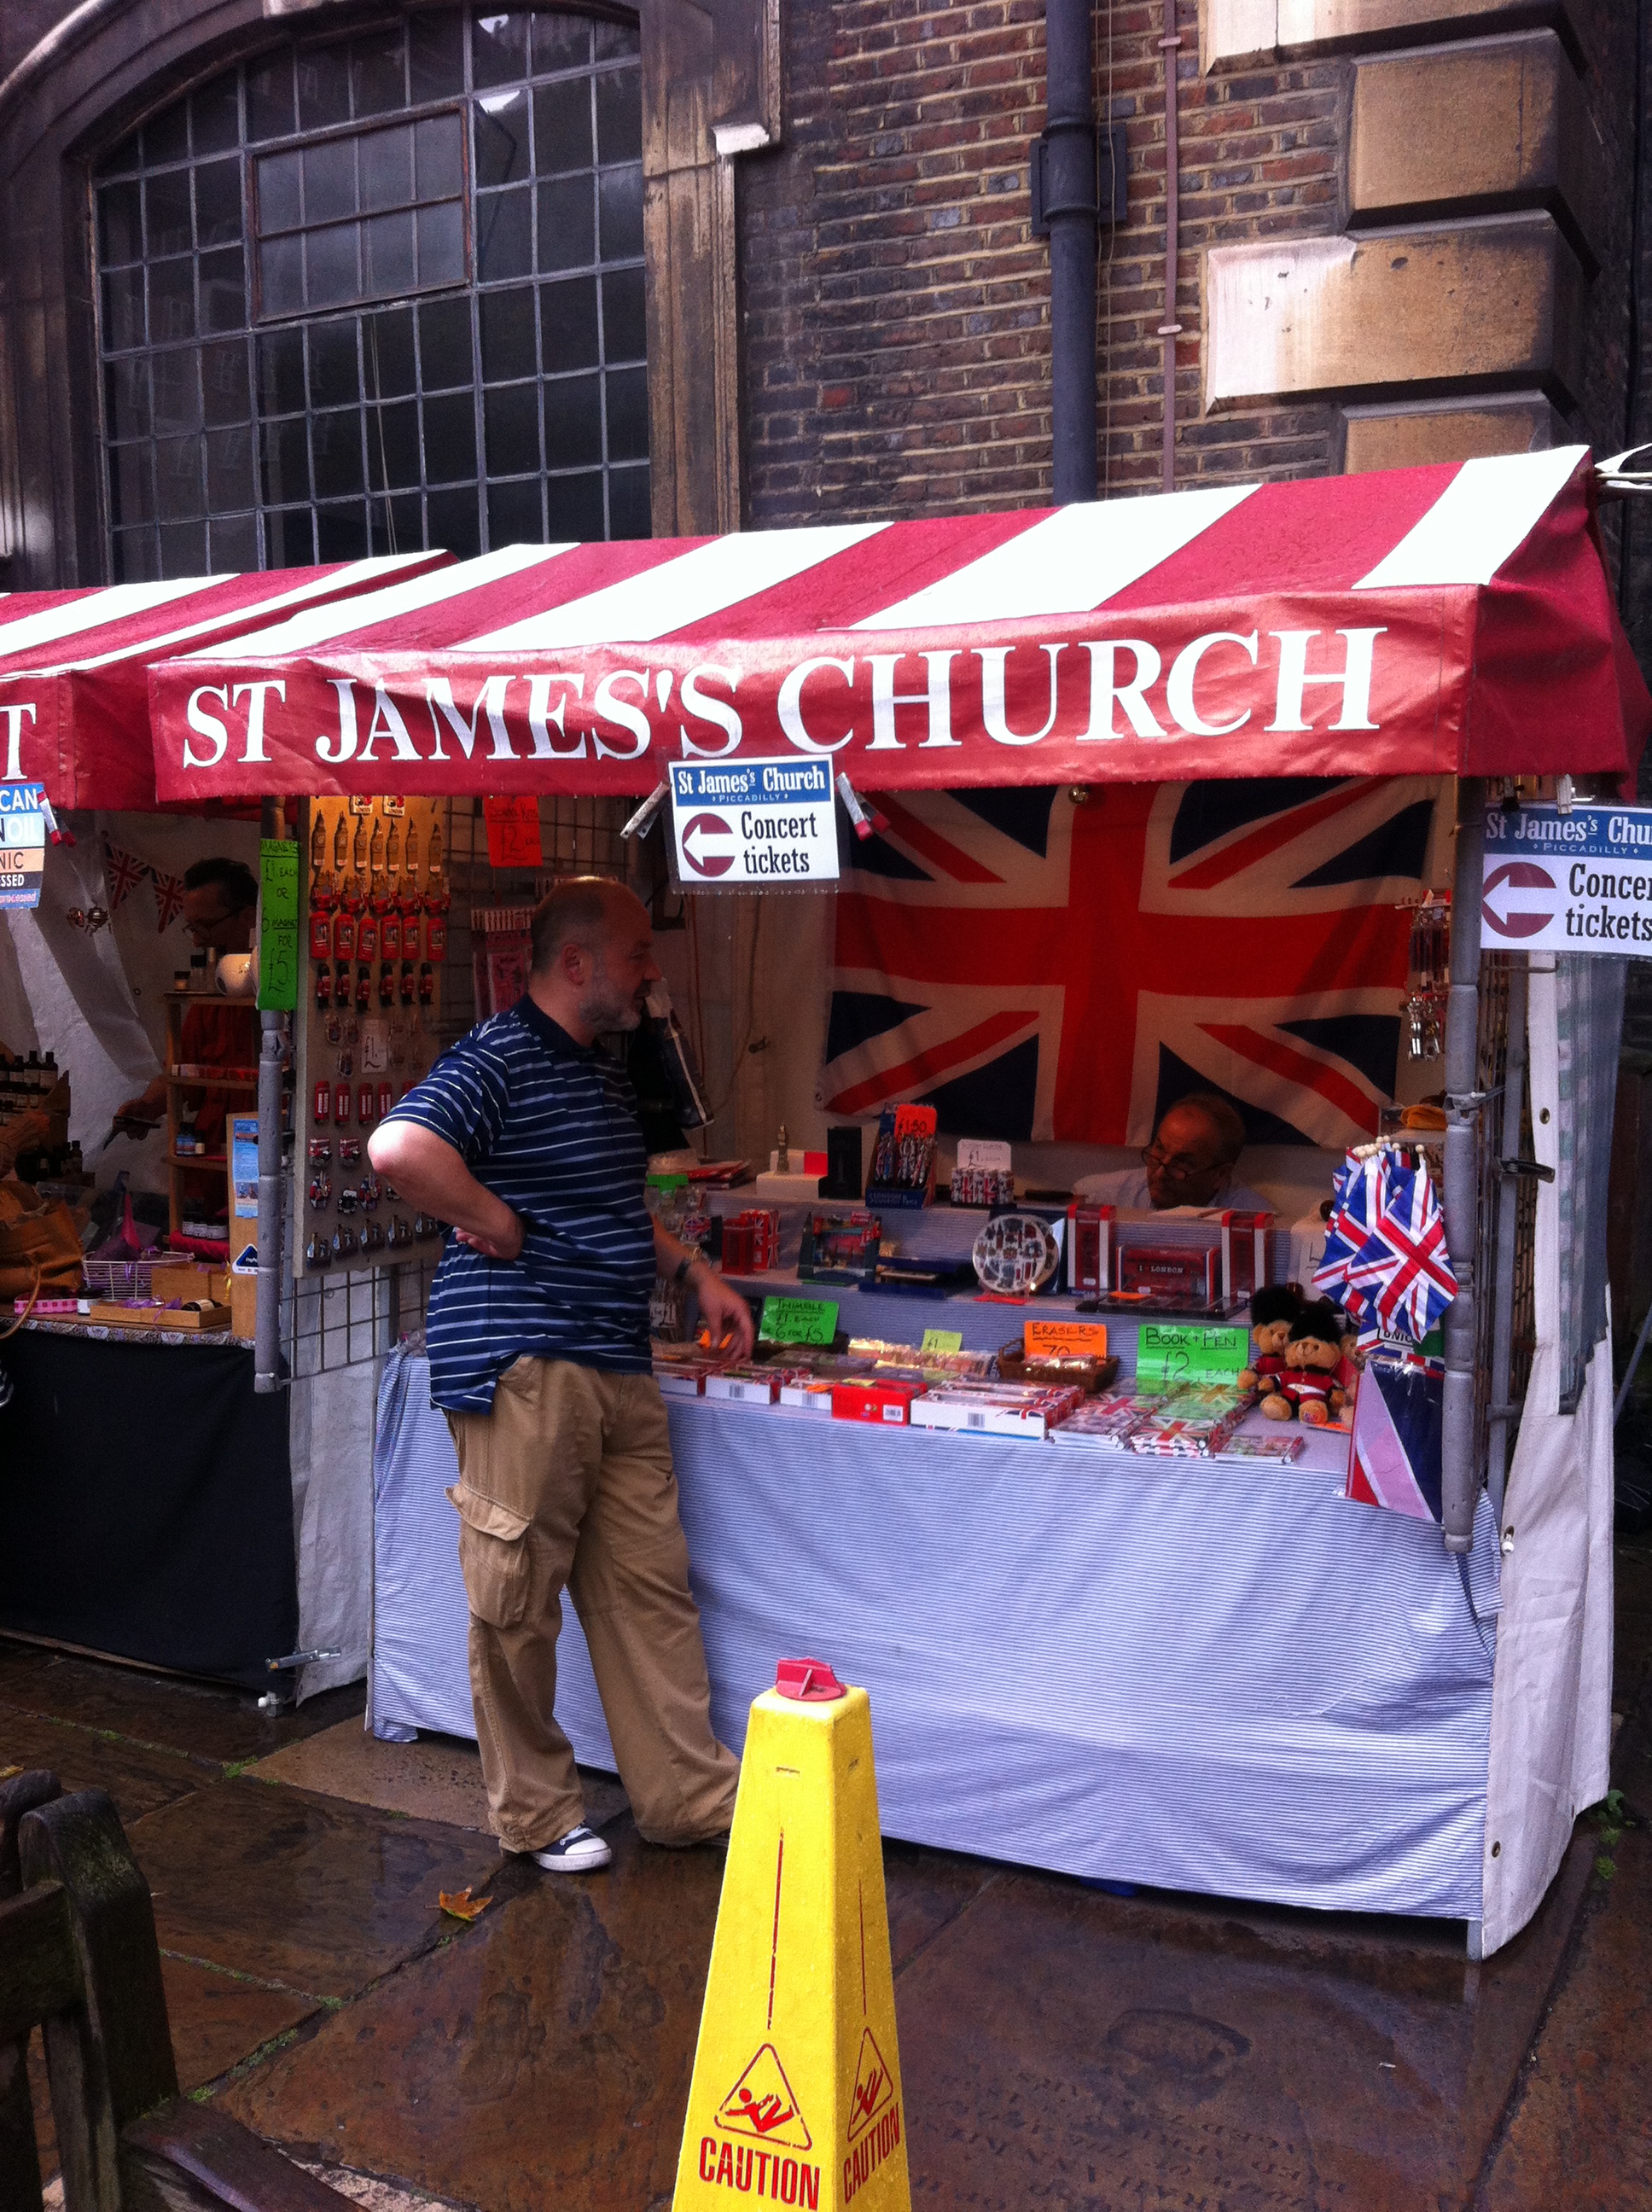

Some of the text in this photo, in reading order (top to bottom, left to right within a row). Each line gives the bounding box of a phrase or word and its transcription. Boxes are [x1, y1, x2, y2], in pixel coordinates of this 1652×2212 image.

[183, 626, 1388, 768] ST JAMES'S CHURCH
[678, 765, 826, 795] St James's Church
[718, 793, 781, 803] PICCADILLY
[741, 811, 818, 840] Concert
[1485, 812, 1508, 840] St
[1514, 812, 1598, 841] James's
[743, 846, 810, 874] tickets
[1543, 842, 1628, 854] PICCADILLY
[0, 874, 25, 888] SSED
[276, 888, 290, 900] OR
[1565, 903, 1652, 941] tickets
[1150, 1265, 1184, 1274] LONDON
[1203, 1328, 1236, 1347] PEN
[843, 2102, 900, 2205] CAUTION
[699, 2136, 821, 2211] CAUTION
